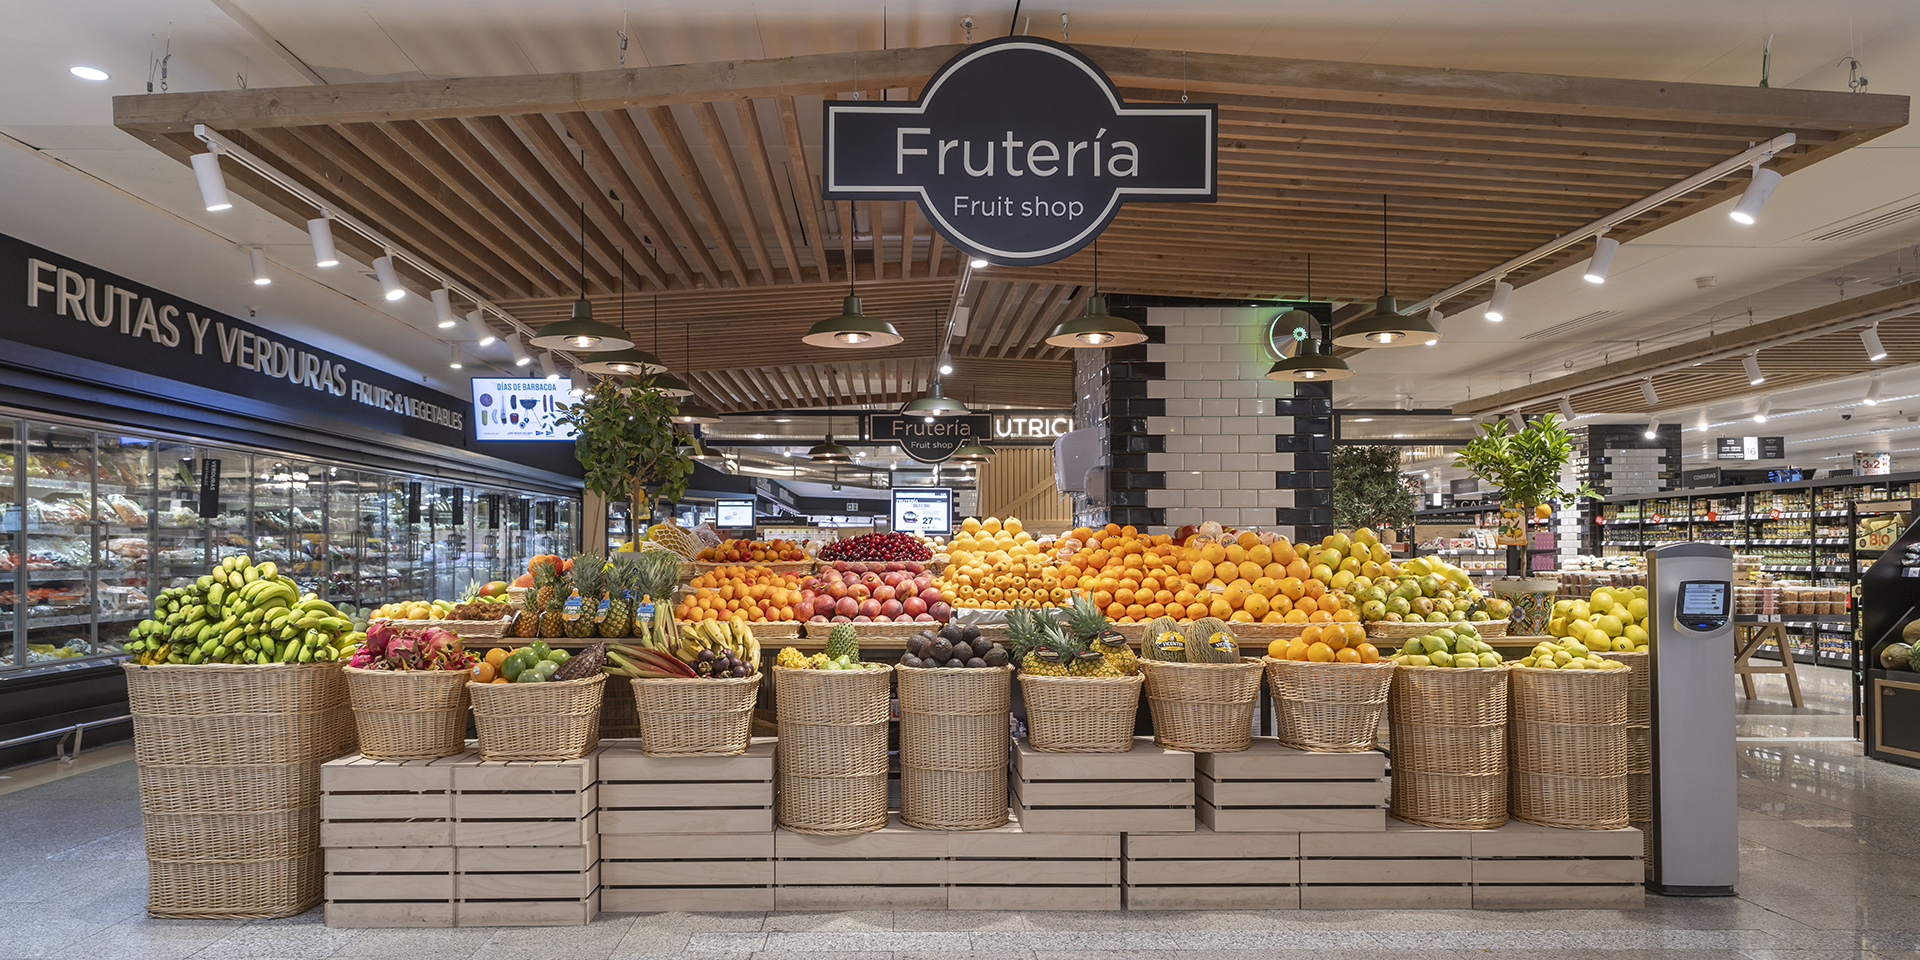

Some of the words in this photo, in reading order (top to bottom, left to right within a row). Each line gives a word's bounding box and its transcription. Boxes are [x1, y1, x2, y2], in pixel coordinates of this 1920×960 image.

[896, 127, 1139, 178] Frutería
[953, 195, 1014, 217] Fruit
[1021, 195, 1084, 220] shop
[27, 258, 181, 348] FRUTAS
[187, 312, 211, 355] Y
[215, 321, 347, 397] VERDURAS
[351, 378, 394, 411] FRUITS
[394, 393, 404, 414] &
[402, 396, 464, 431] VEGETABLES
[496, 382, 512, 391] DÍAS
[513, 383, 521, 391] DE
[523, 383, 557, 391] BARBACOA
[892, 419, 971, 436] Frutería
[911, 441, 931, 449] Fruit
[932, 441, 954, 450] shop
[1862, 460, 1880, 469] 3x2
